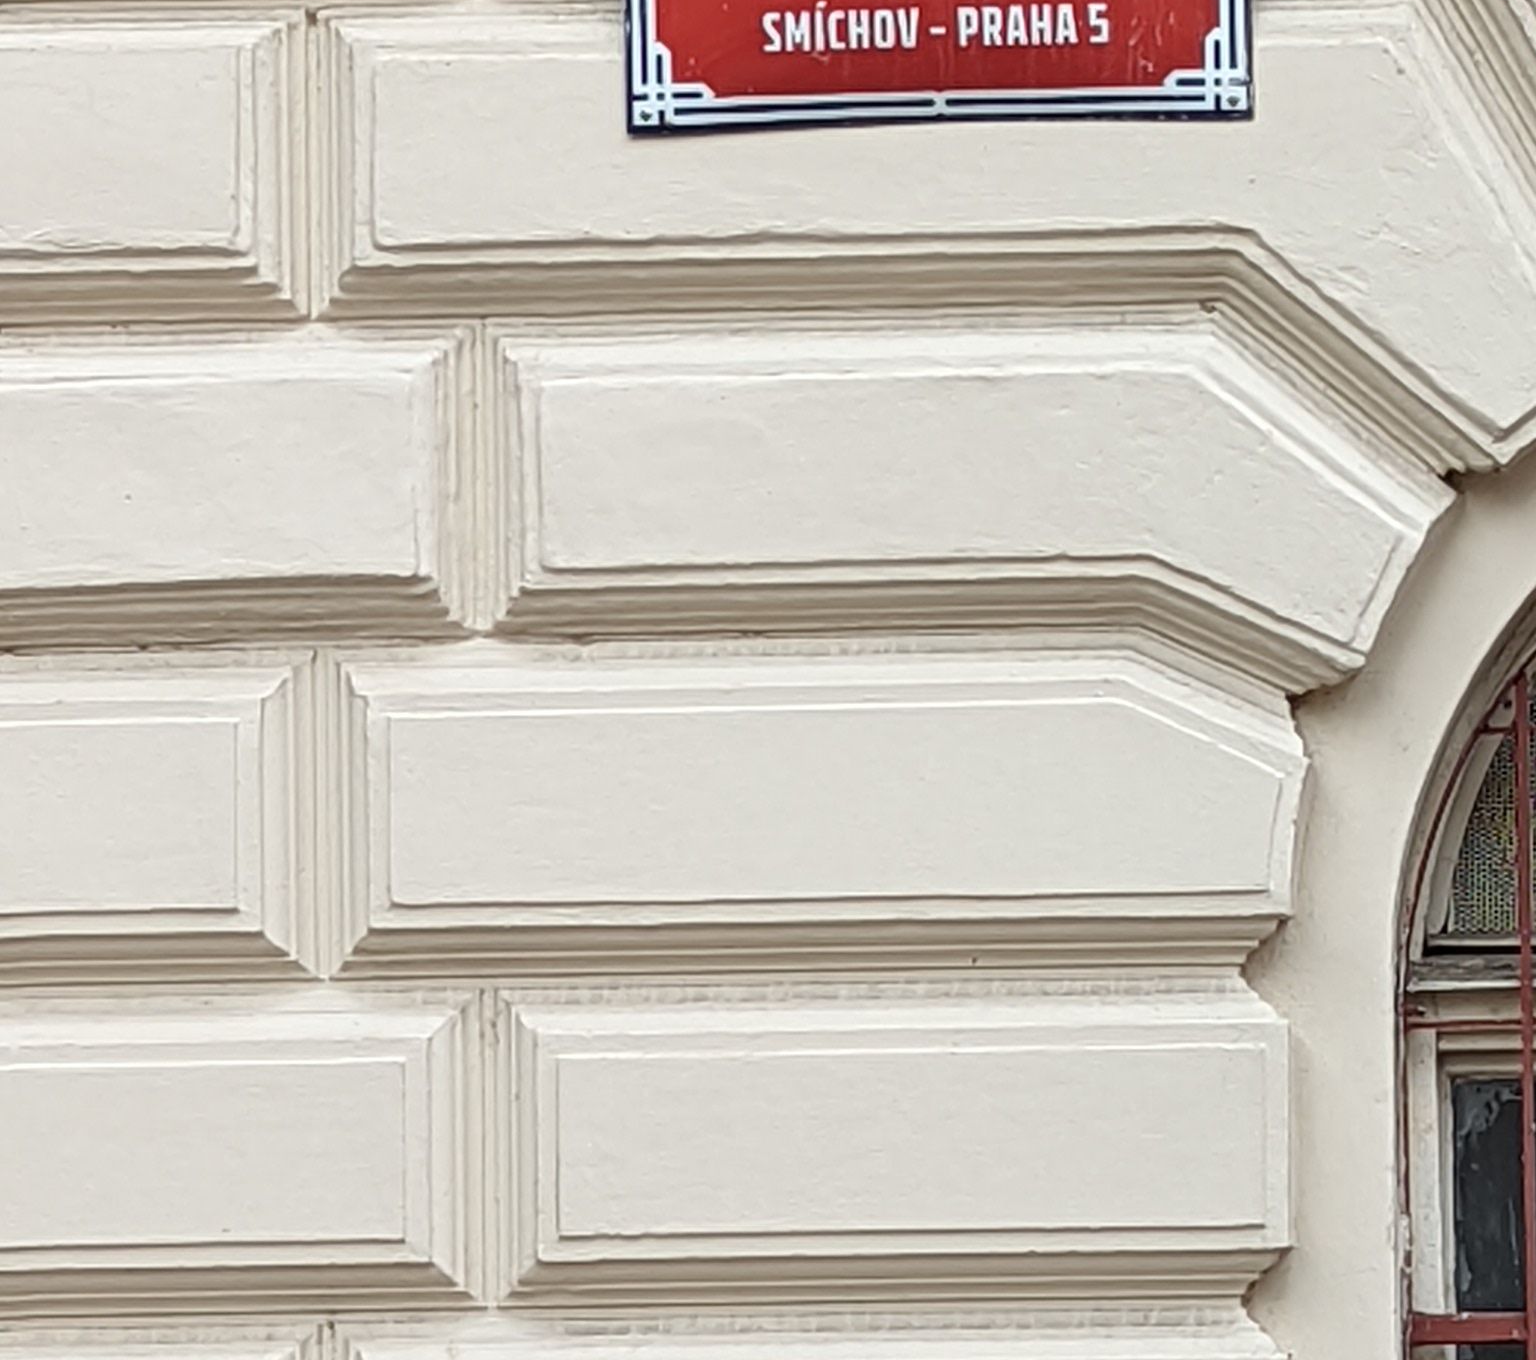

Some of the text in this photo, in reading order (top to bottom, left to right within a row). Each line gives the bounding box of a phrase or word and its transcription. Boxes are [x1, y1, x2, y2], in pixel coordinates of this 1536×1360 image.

[761, 1, 920, 53] SMÍCHOV
[956, 2, 1080, 48] PRAHA
[1087, 2, 1111, 44] 5
